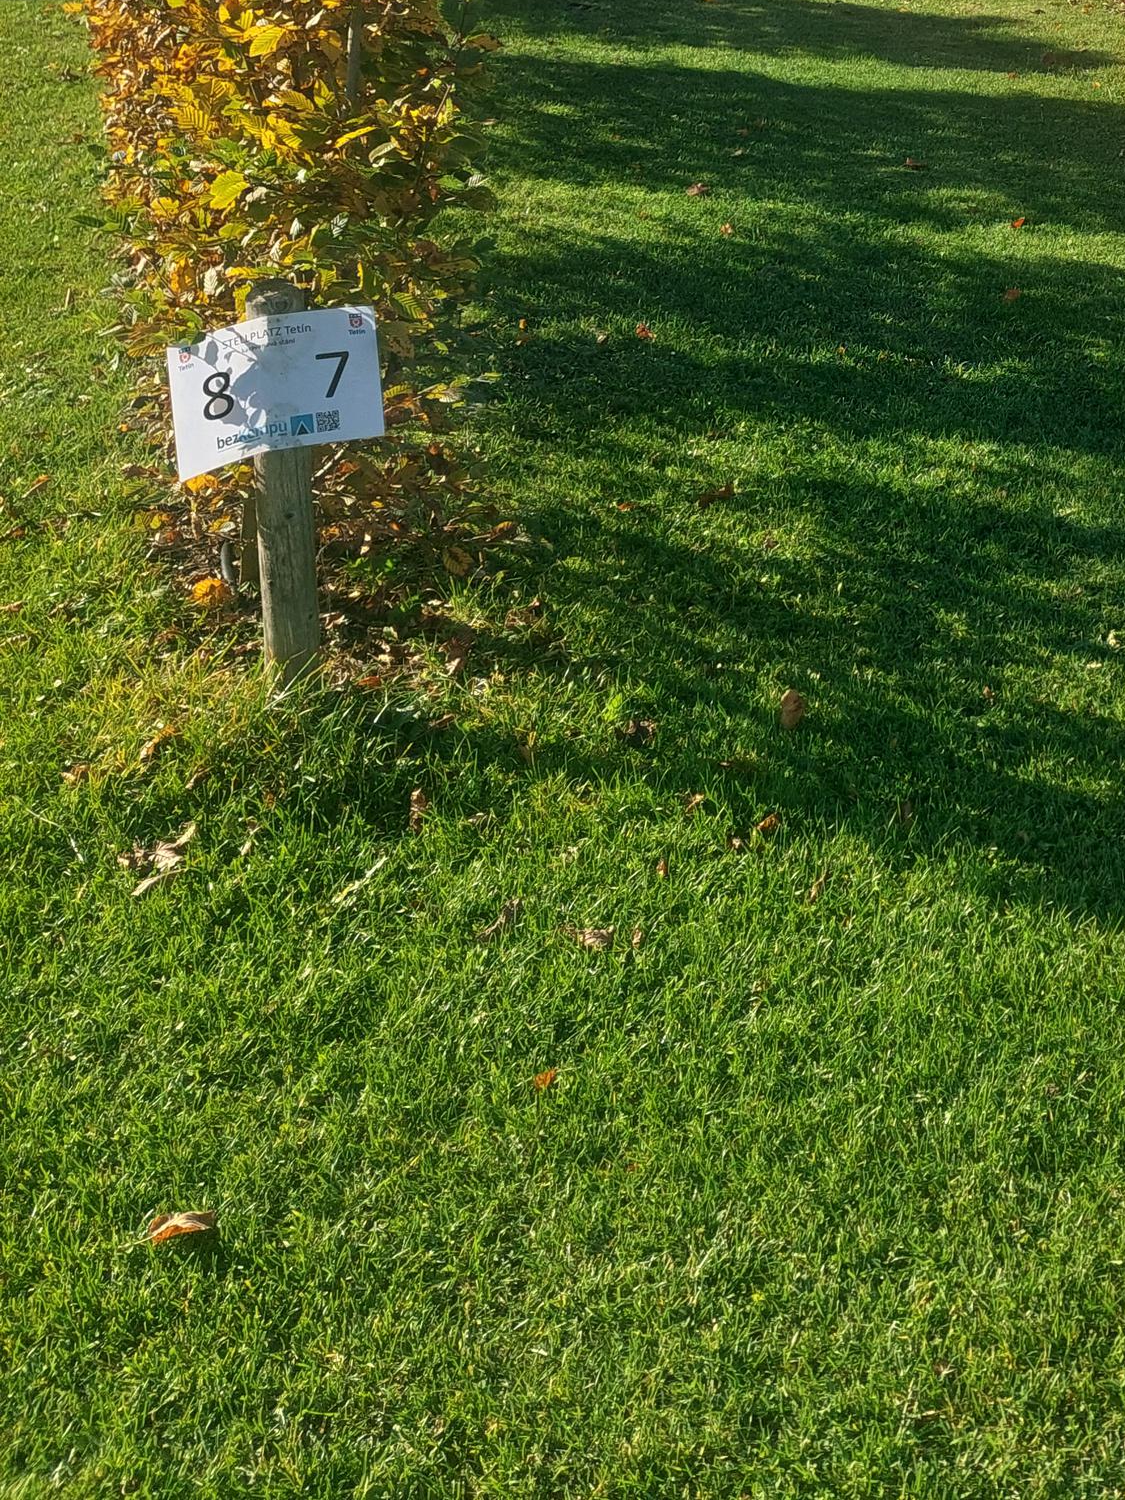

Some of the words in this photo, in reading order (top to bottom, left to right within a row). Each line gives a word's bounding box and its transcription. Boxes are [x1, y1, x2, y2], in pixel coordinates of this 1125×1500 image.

[222, 327, 282, 350] STELLPLATZ
[285, 323, 312, 336] Tetín
[348, 328, 366, 336] Tetín
[315, 350, 349, 398] 7
[202, 371, 235, 421] 8
